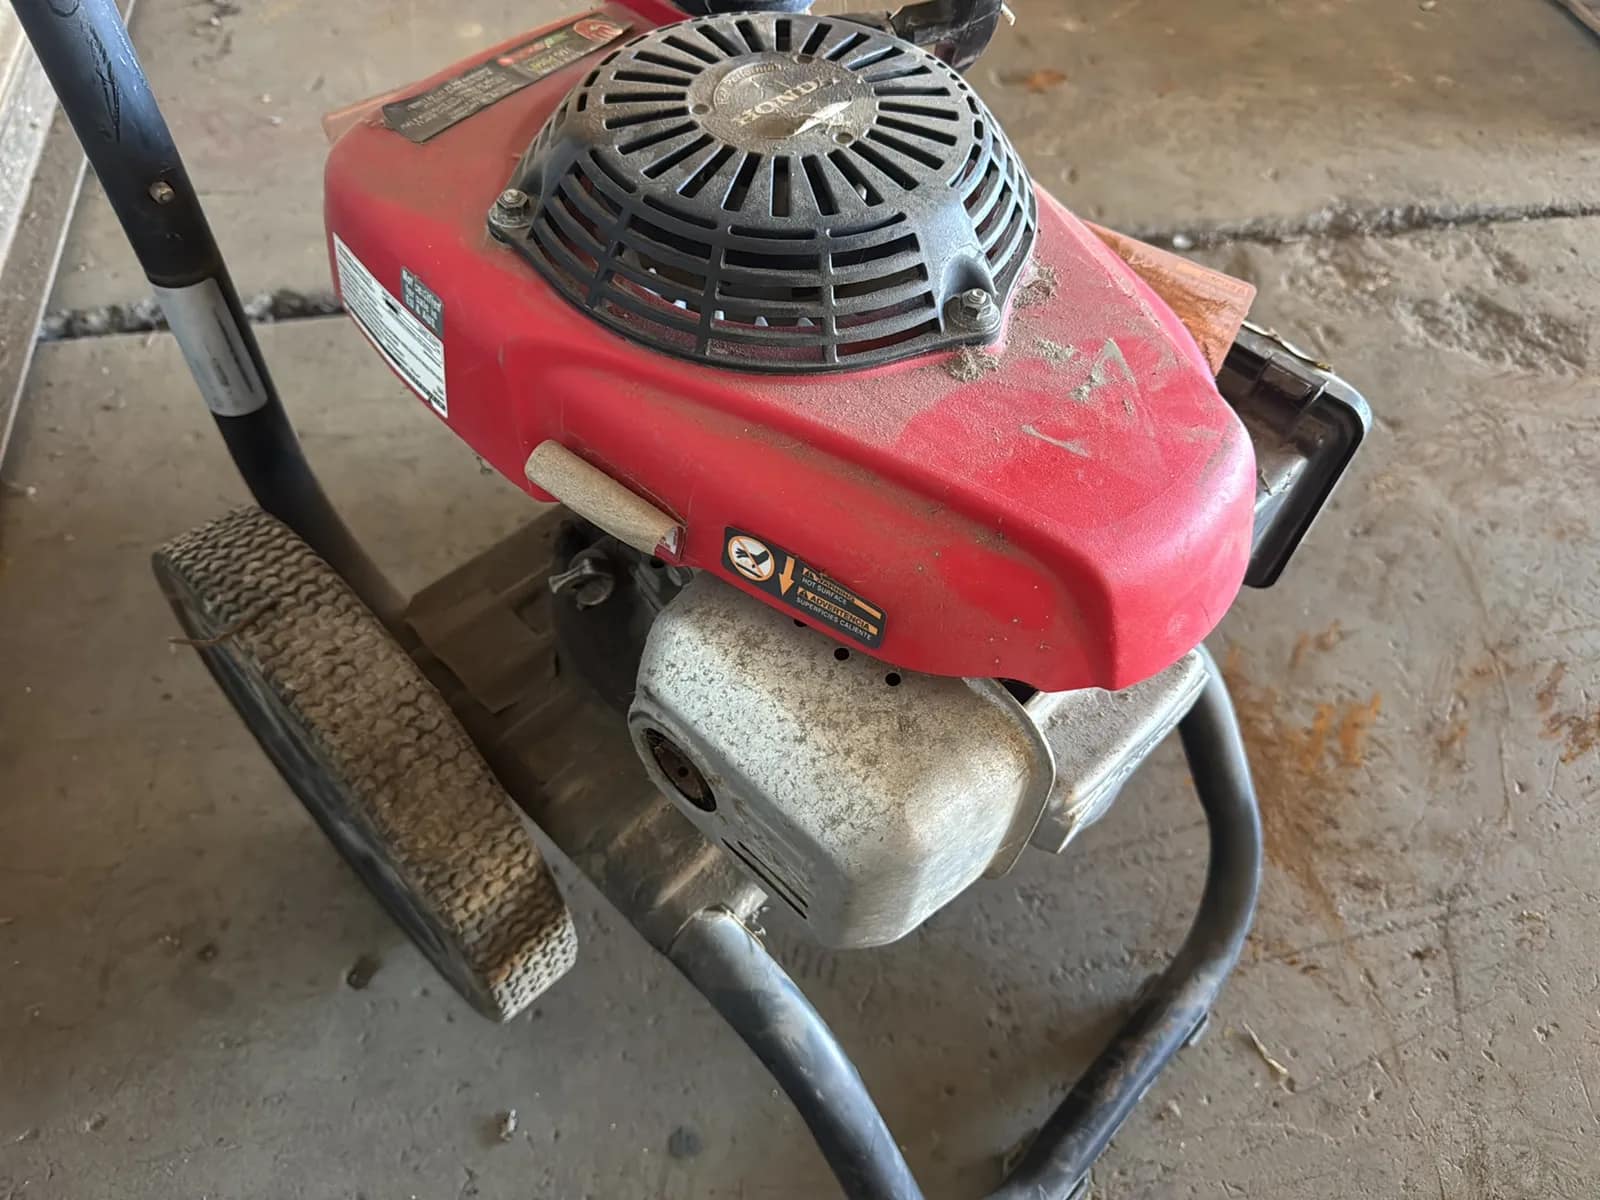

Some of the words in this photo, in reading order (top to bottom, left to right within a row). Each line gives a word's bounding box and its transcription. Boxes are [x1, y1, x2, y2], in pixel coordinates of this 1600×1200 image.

[801, 577, 818, 590] HOT
[816, 584, 848, 605] SURFACE
[796, 596, 839, 623] SUPERFICIES
[838, 618, 872, 641] CALIENTE
[810, 594, 871, 630] ADVERTENCIA
